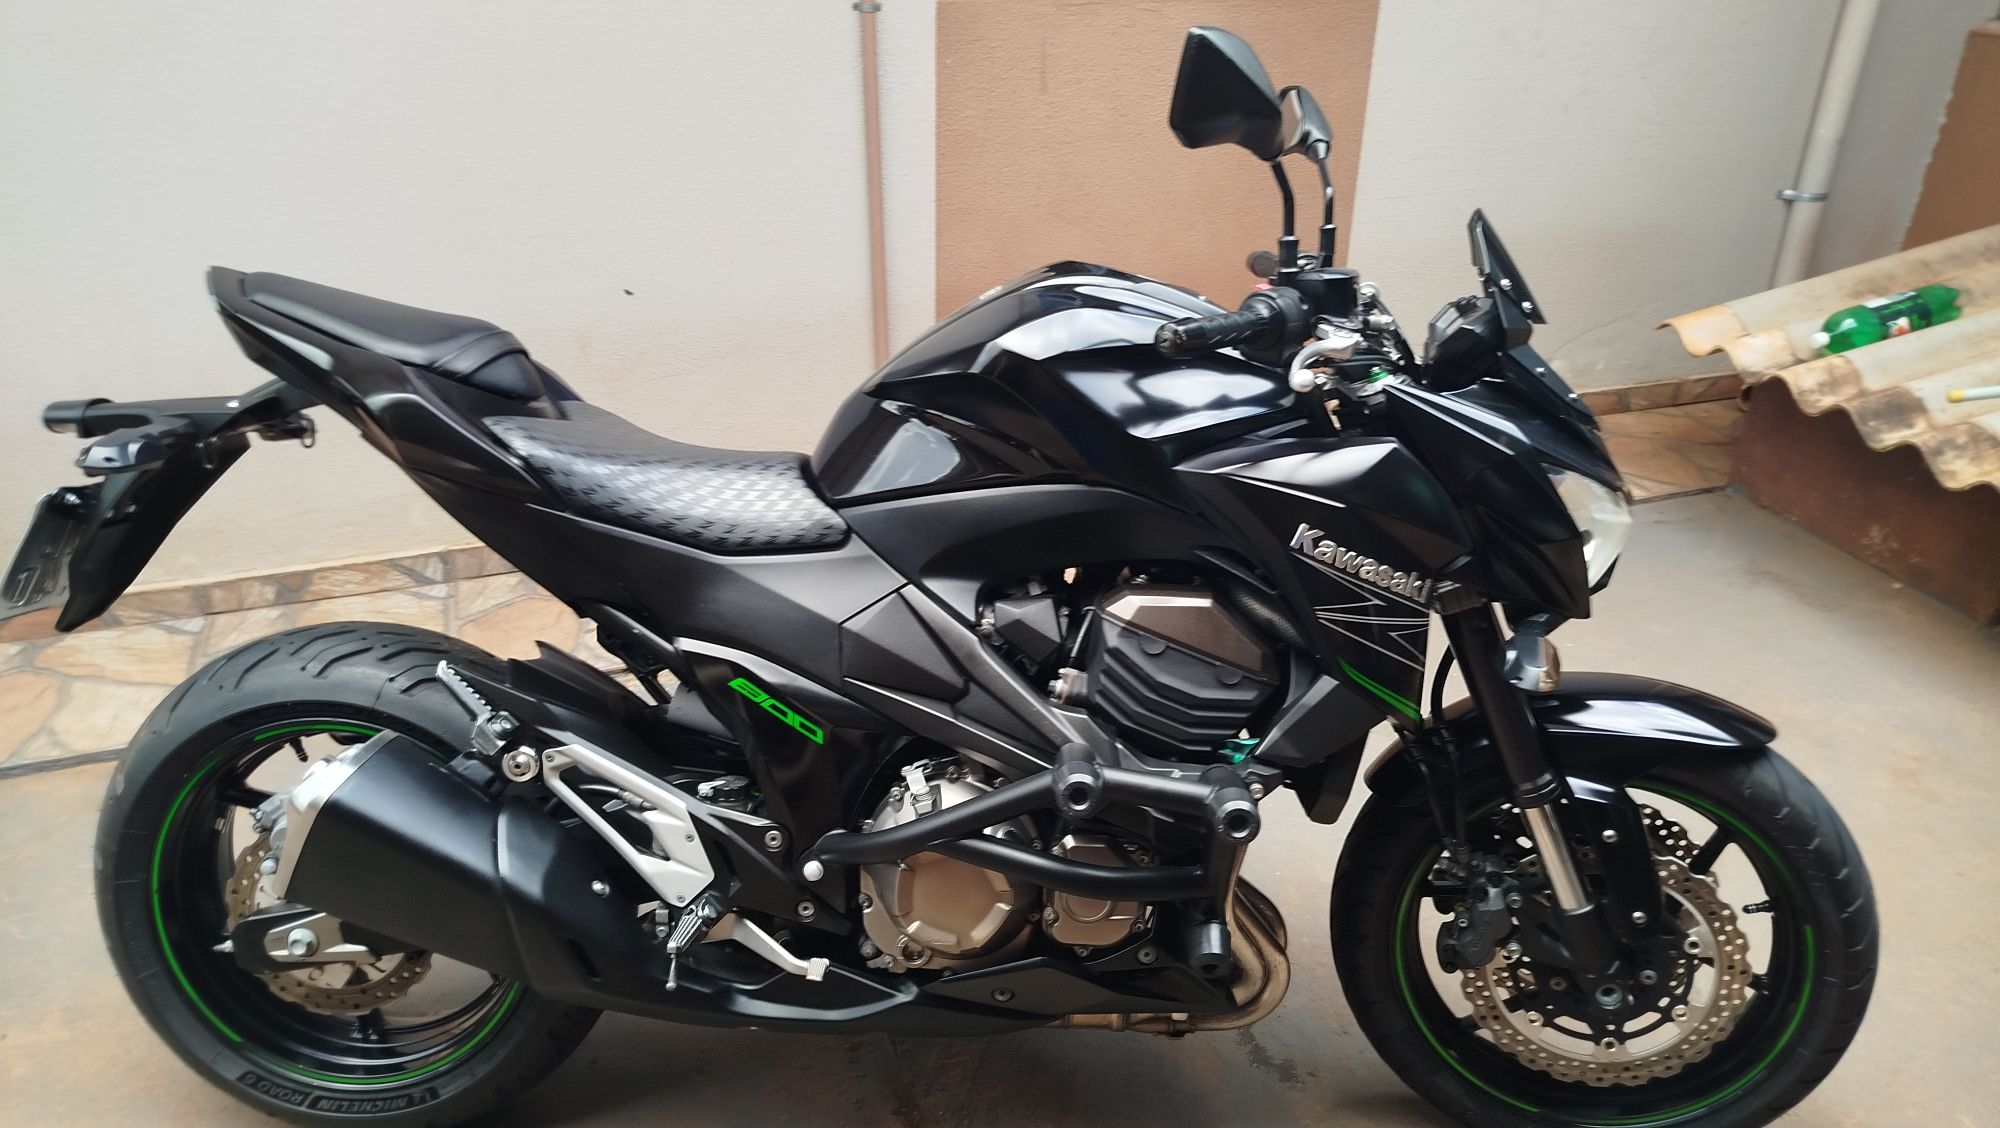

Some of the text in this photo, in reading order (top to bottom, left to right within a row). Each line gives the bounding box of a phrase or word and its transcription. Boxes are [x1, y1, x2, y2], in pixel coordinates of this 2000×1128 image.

[1290, 522, 1432, 604] Kawasaki
[728, 677, 824, 744] 800
[246, 1073, 303, 1104] ROAD 6
[318, 1096, 408, 1113] MICHELIN
